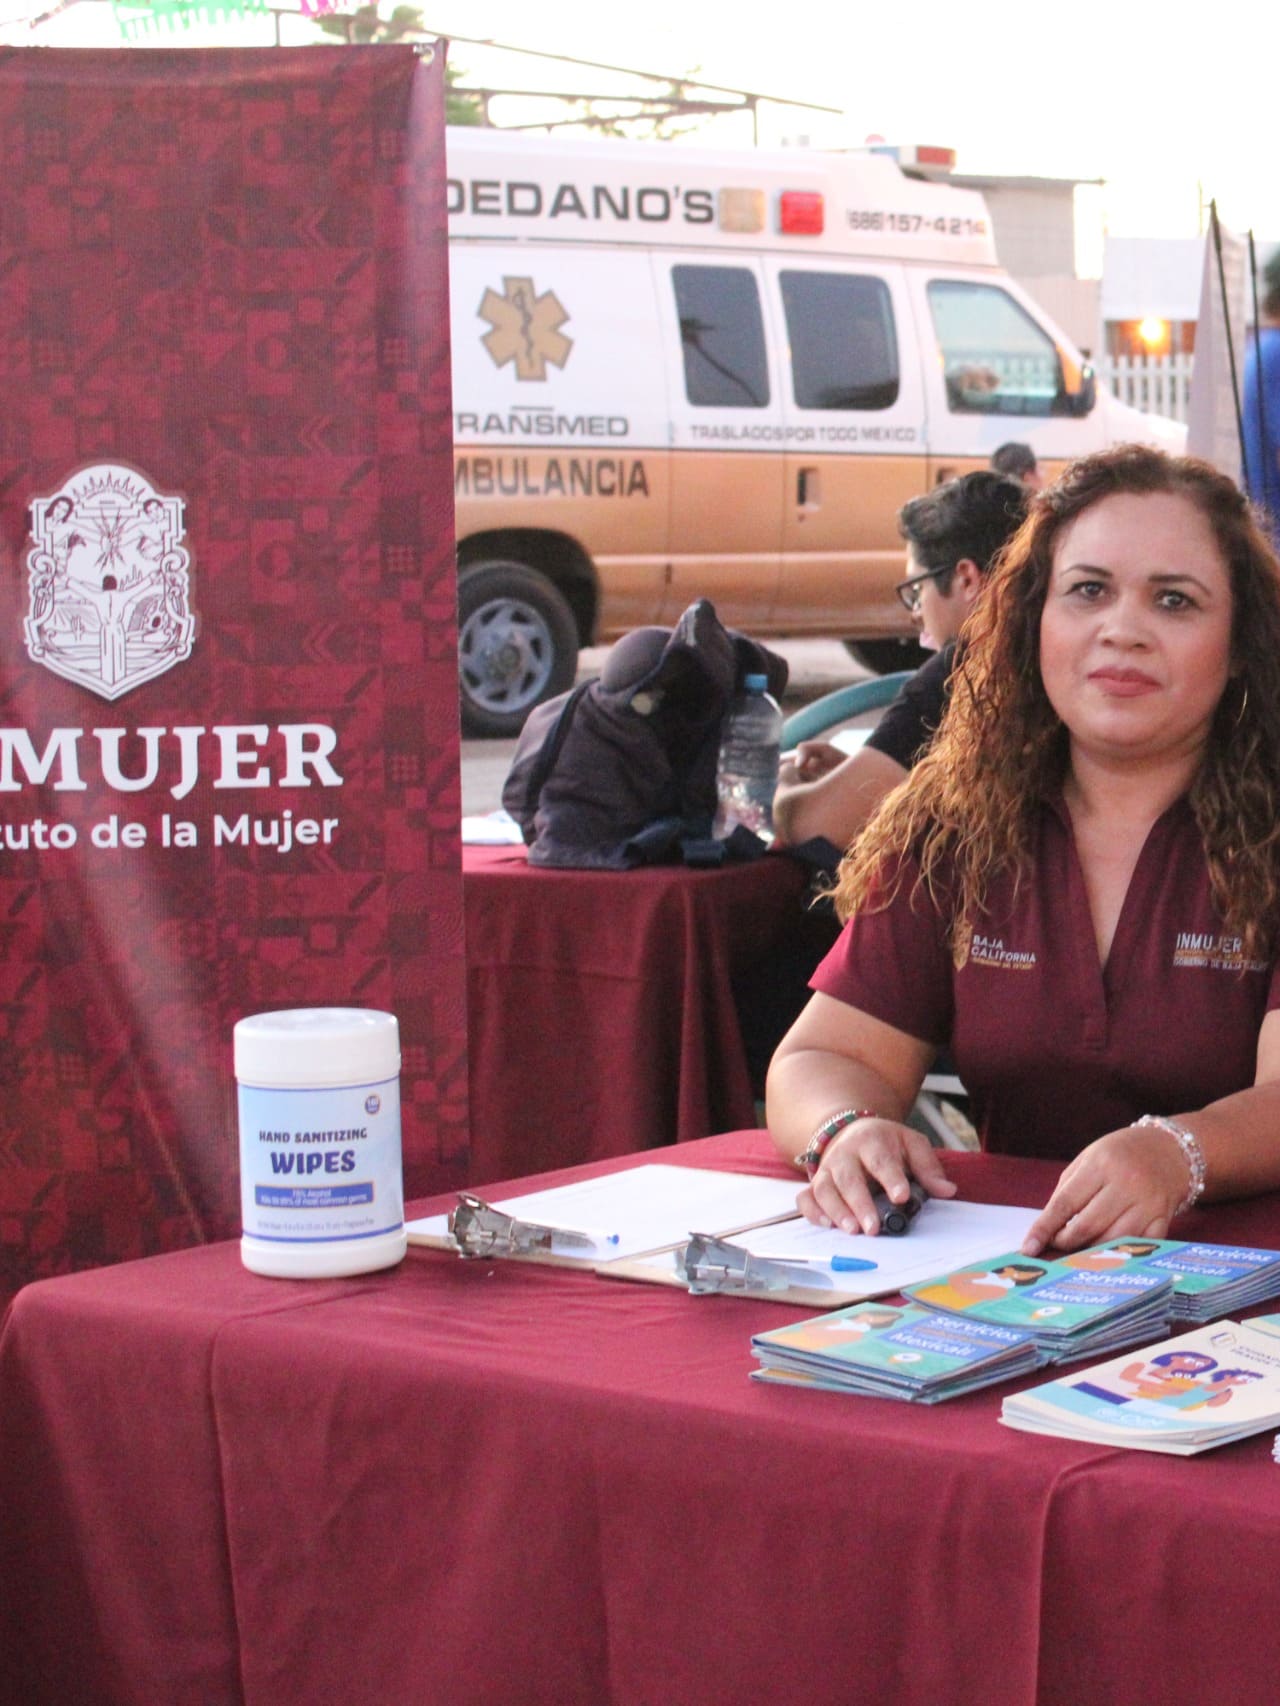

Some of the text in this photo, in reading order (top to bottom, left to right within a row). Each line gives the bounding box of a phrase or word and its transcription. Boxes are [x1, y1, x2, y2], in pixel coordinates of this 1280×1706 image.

[0, 723, 344, 800] MUJER
[90, 814, 147, 848] de
[161, 813, 197, 847] la
[213, 809, 339, 853] Mujer
[970, 945, 1037, 964] CALIFORNIA
[259, 1127, 368, 1143] HAND SANITIZING
[270, 1149, 356, 1175] WIPES
